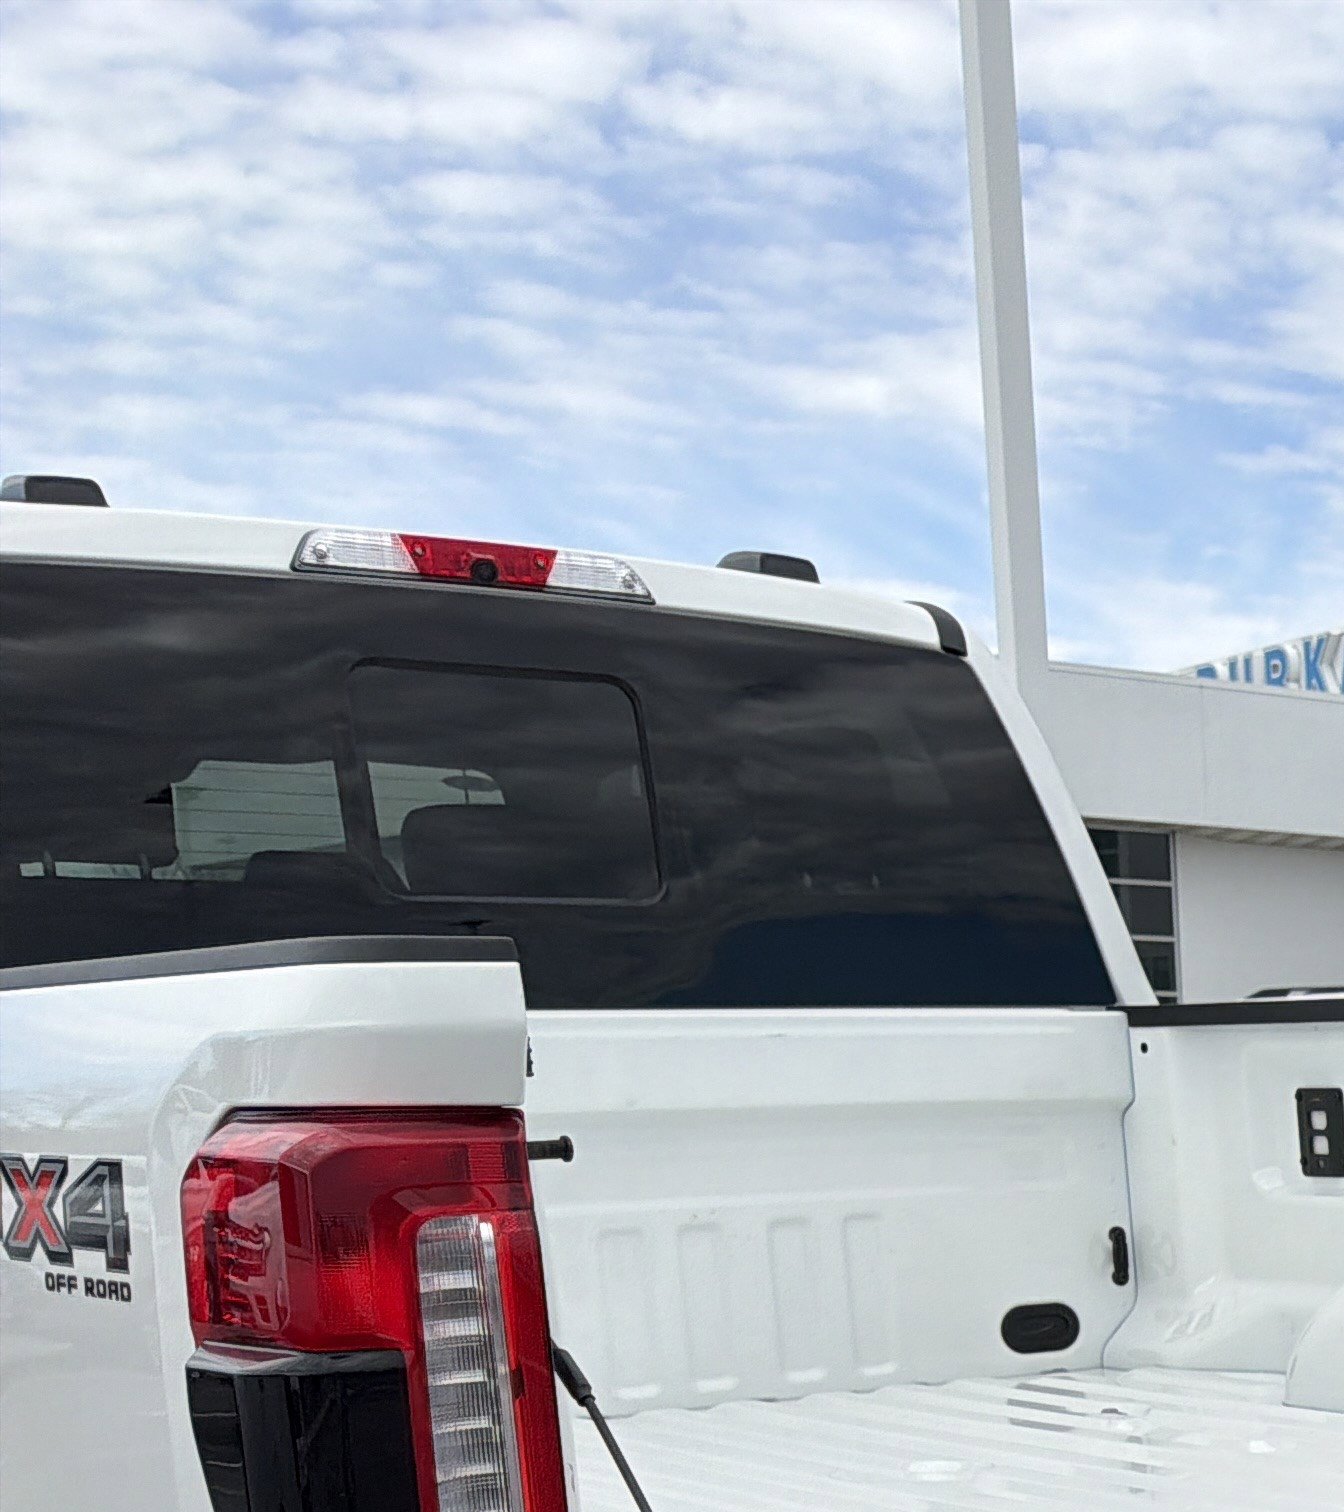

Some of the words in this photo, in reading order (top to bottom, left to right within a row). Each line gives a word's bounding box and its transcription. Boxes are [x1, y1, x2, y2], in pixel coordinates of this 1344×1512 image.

[0, 1152, 132, 1274] X4
[44, 1271, 78, 1295] OFF
[83, 1277, 132, 1303] ROAD
